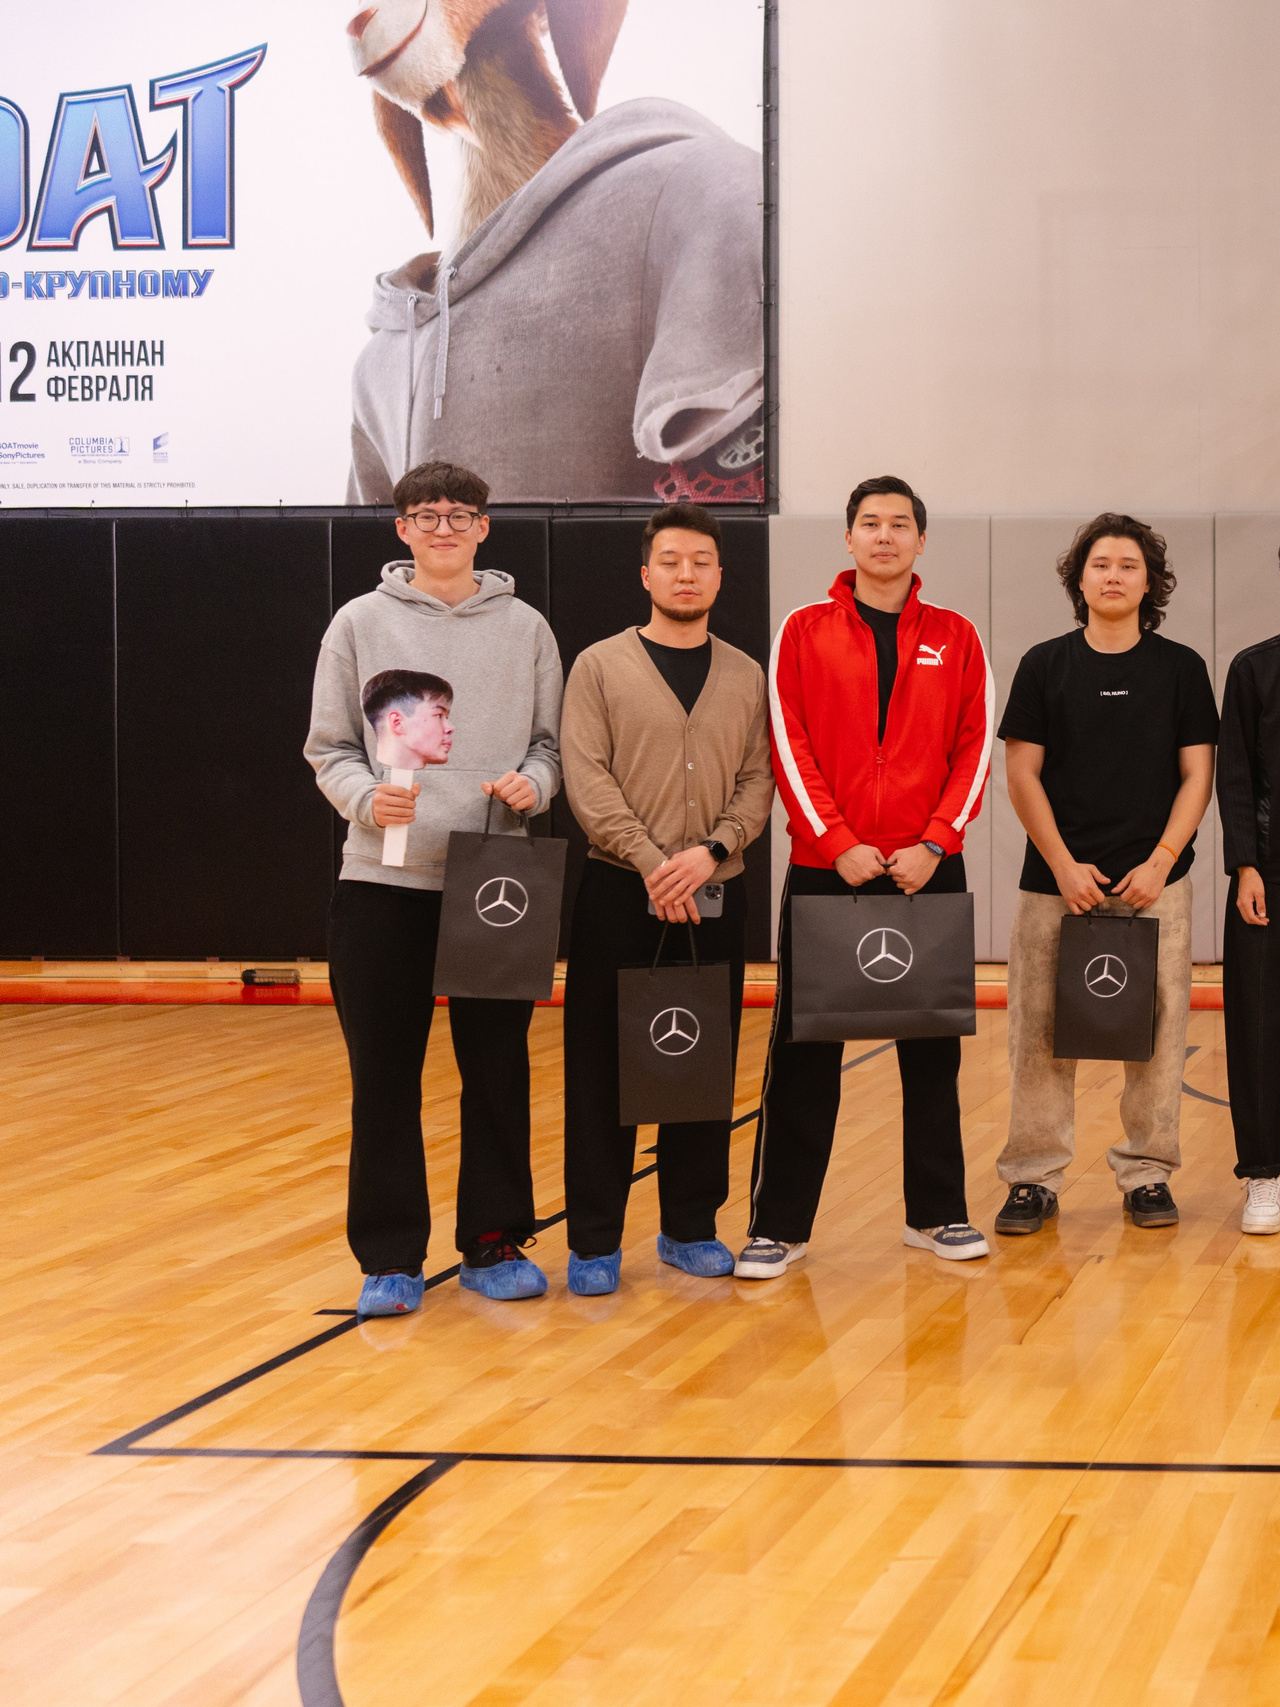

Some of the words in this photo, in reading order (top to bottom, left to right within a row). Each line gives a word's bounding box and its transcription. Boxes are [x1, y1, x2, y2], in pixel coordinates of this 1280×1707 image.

[0, 42, 268, 252] AT
[46, 340, 165, 371] АҚПАННАН
[0, 340, 37, 402] 2
[46, 375, 154, 402] ФЕВРАЛЯ
[0, 442, 39, 450] OATmovie
[69, 437, 114, 446] COLUMBIA
[70, 445, 113, 454] PICTURES
